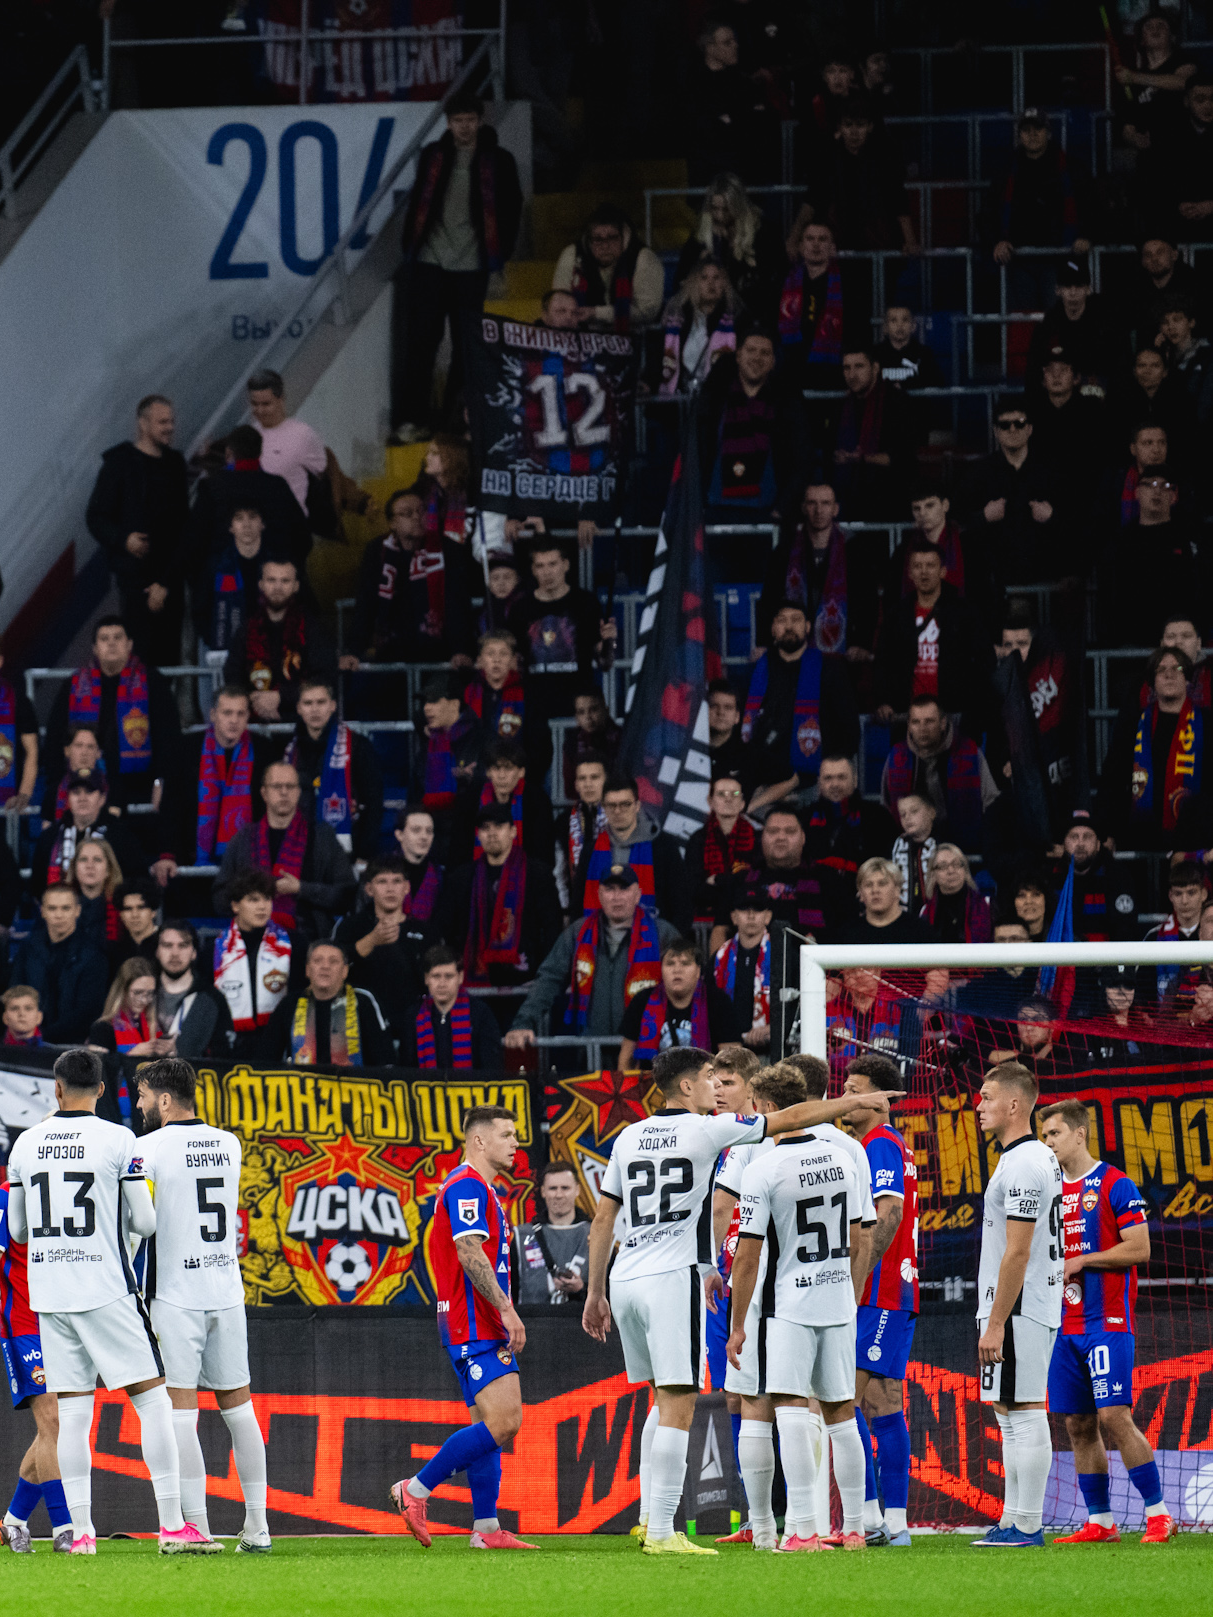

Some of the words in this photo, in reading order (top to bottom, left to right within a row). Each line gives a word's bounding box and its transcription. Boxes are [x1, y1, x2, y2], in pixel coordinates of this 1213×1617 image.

[232, 314, 314, 341] Выо
[526, 372, 611, 446] 12
[481, 468, 512, 497] НА
[515, 472, 600, 503] СЕРДЦЕ
[227, 1066, 410, 1140] ФАНАТЫ
[44, 1132, 82, 1141] FONBET
[187, 1140, 221, 1148] FONBET
[638, 1136, 677, 1150] ХОДЖА
[37, 1145, 85, 1160] УРОЗОВ
[185, 1153, 231, 1168] ВУЯЧИЧ
[800, 1154, 833, 1167] FONBET
[798, 1166, 845, 1188] РОЖКОВ
[876, 1169, 895, 1179] FON
[1085, 1176, 1102, 1187] wb
[876, 1178, 894, 1187] BET
[627, 1158, 694, 1228] 22
[30, 1171, 96, 1238] 13
[196, 1177, 227, 1243] 5
[287, 1184, 411, 1242] ЦСКА
[795, 1191, 851, 1264] 51
[47, 1255, 103, 1263] ОРГСИНТЕЗ
[48, 1249, 85, 1257] КАЗАНЬ
[23, 1348, 42, 1363] wb
[1087, 1344, 1111, 1379] 10
